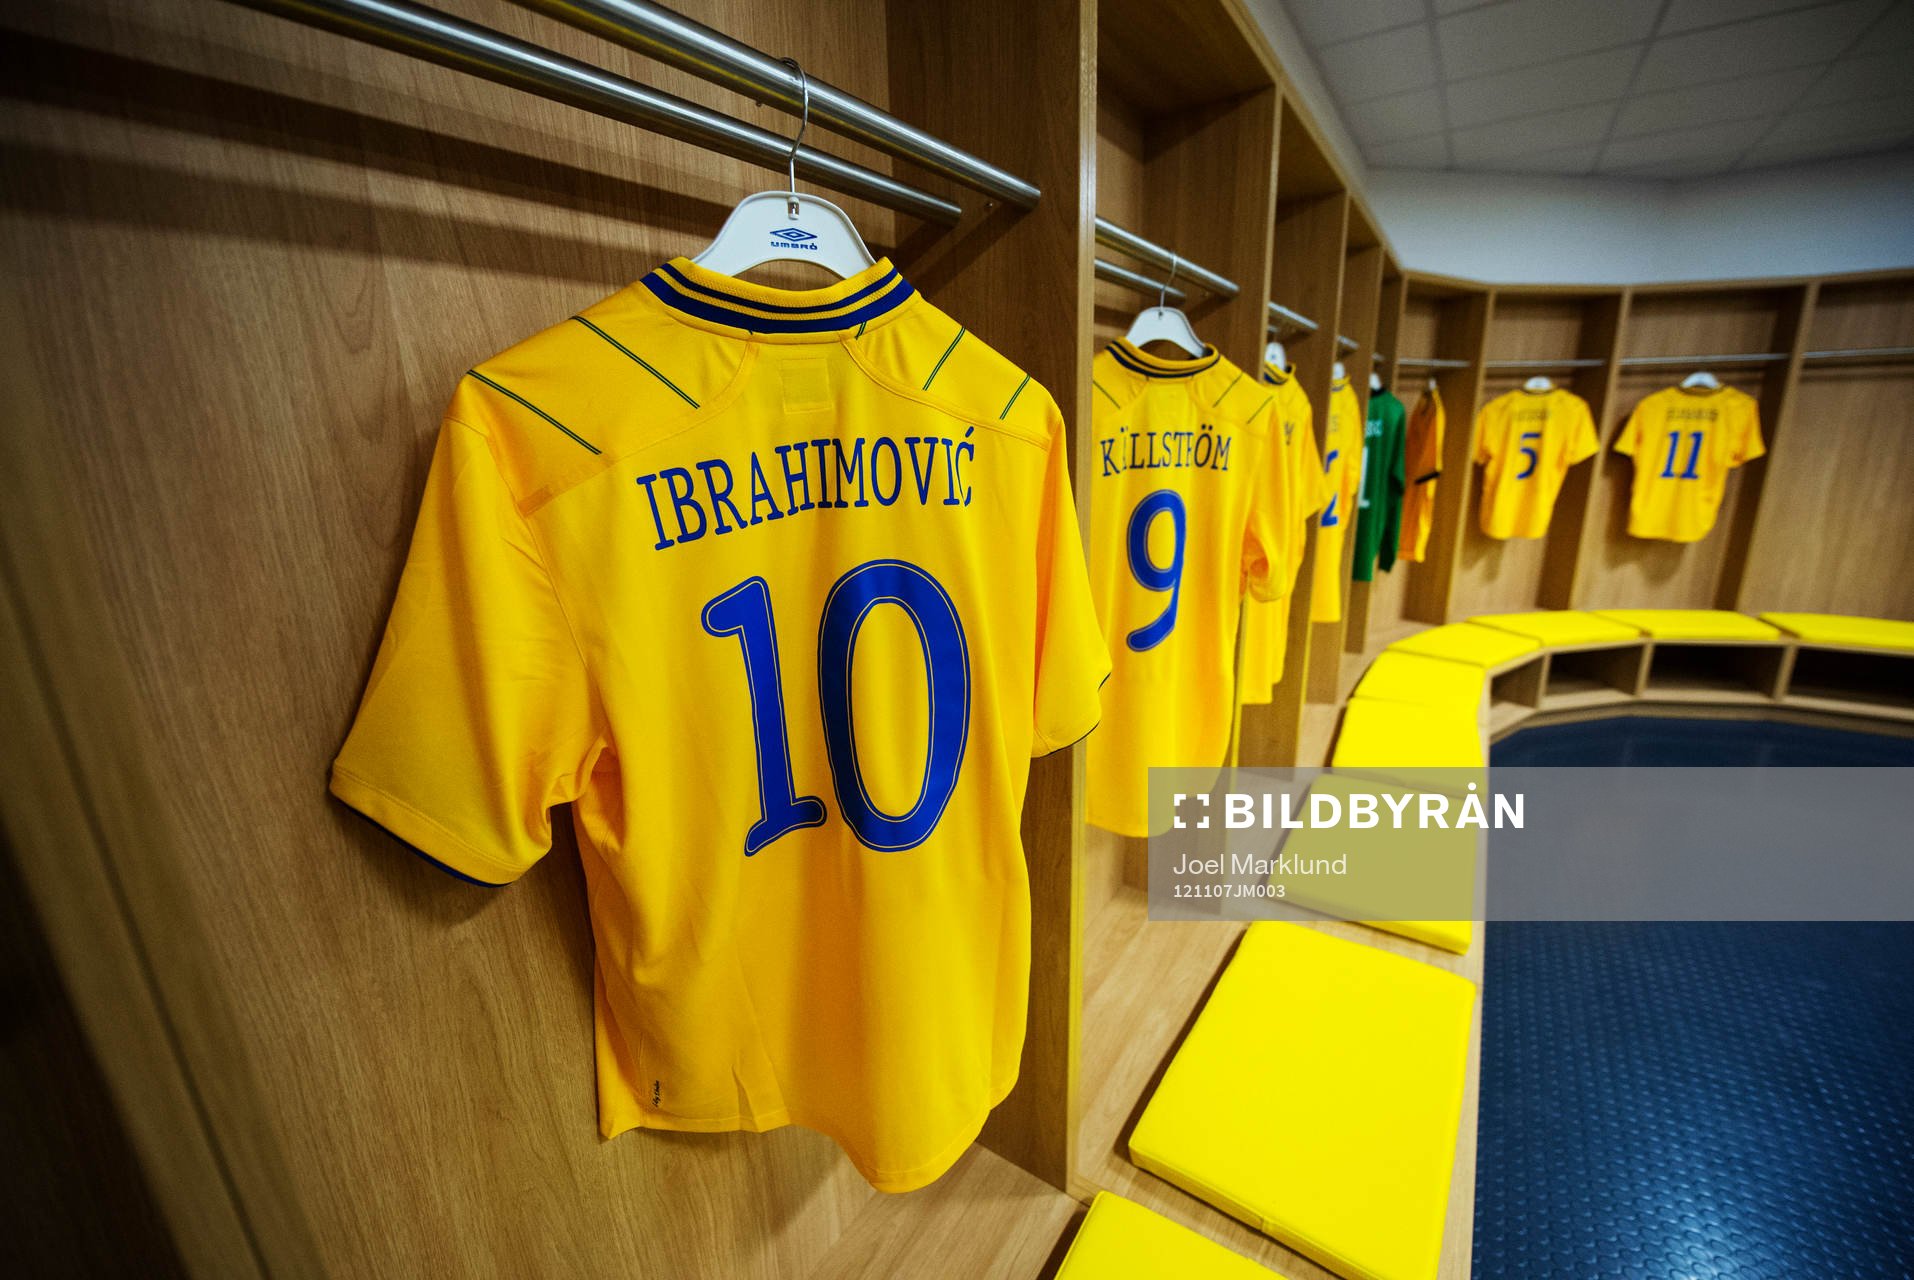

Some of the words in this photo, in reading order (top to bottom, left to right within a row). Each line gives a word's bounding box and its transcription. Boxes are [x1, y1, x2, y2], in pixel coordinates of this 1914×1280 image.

[636, 426, 975, 551] IBRAHIMOVIĆ
[1100, 423, 1231, 477] KLLSTÖM
[1516, 432, 1542, 479] 5
[1660, 431, 1704, 479] 11
[1126, 489, 1186, 652] 9
[701, 558, 971, 857] 10
